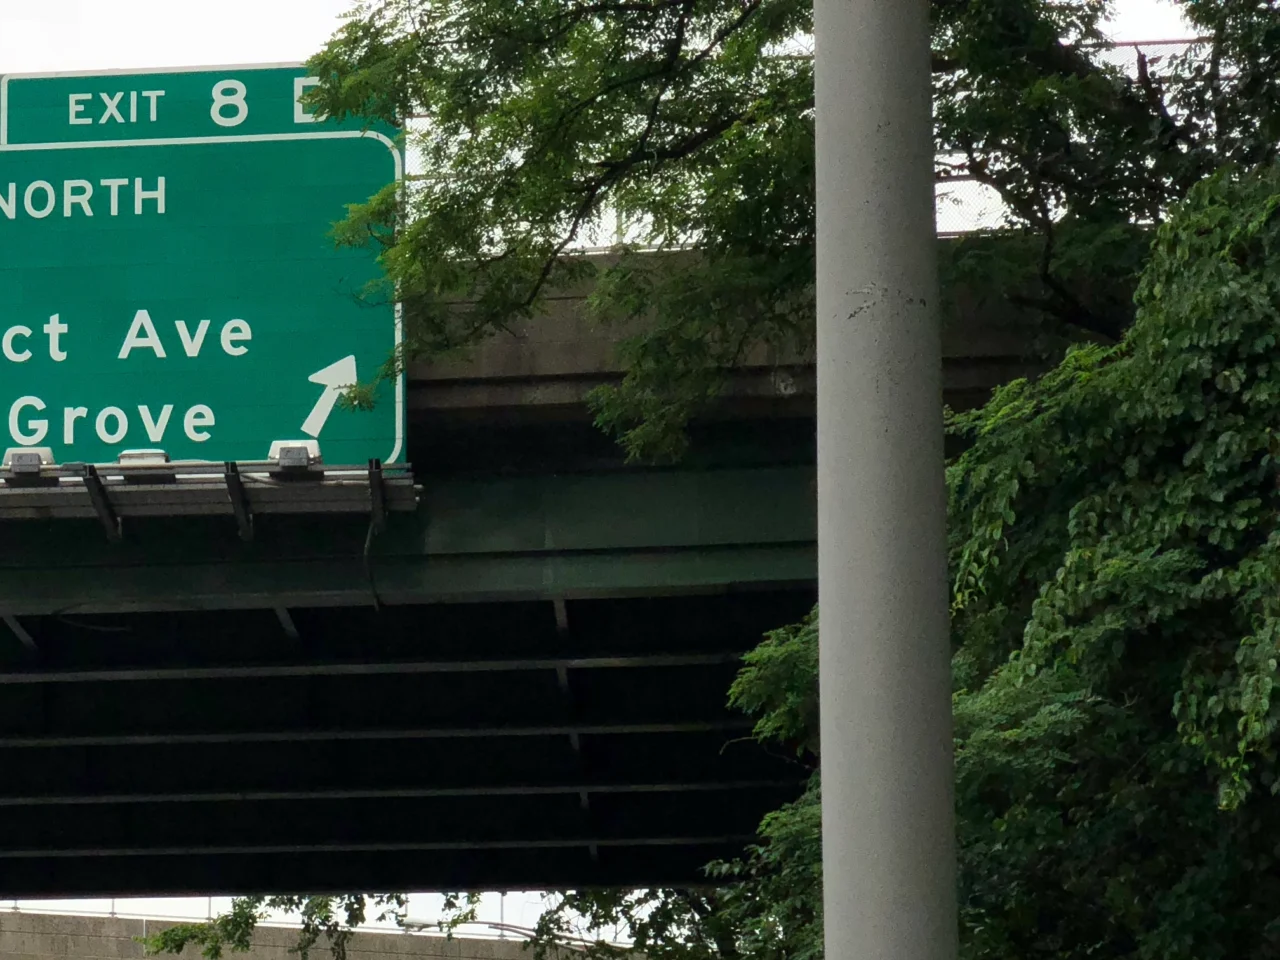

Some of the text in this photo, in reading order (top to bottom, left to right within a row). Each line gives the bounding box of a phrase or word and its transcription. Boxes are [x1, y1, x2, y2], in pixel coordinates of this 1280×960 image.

[68, 90, 166, 125] EXIT
[210, 79, 249, 127] 8
[117, 309, 253, 360] Ave
[8, 396, 216, 446] Grove
